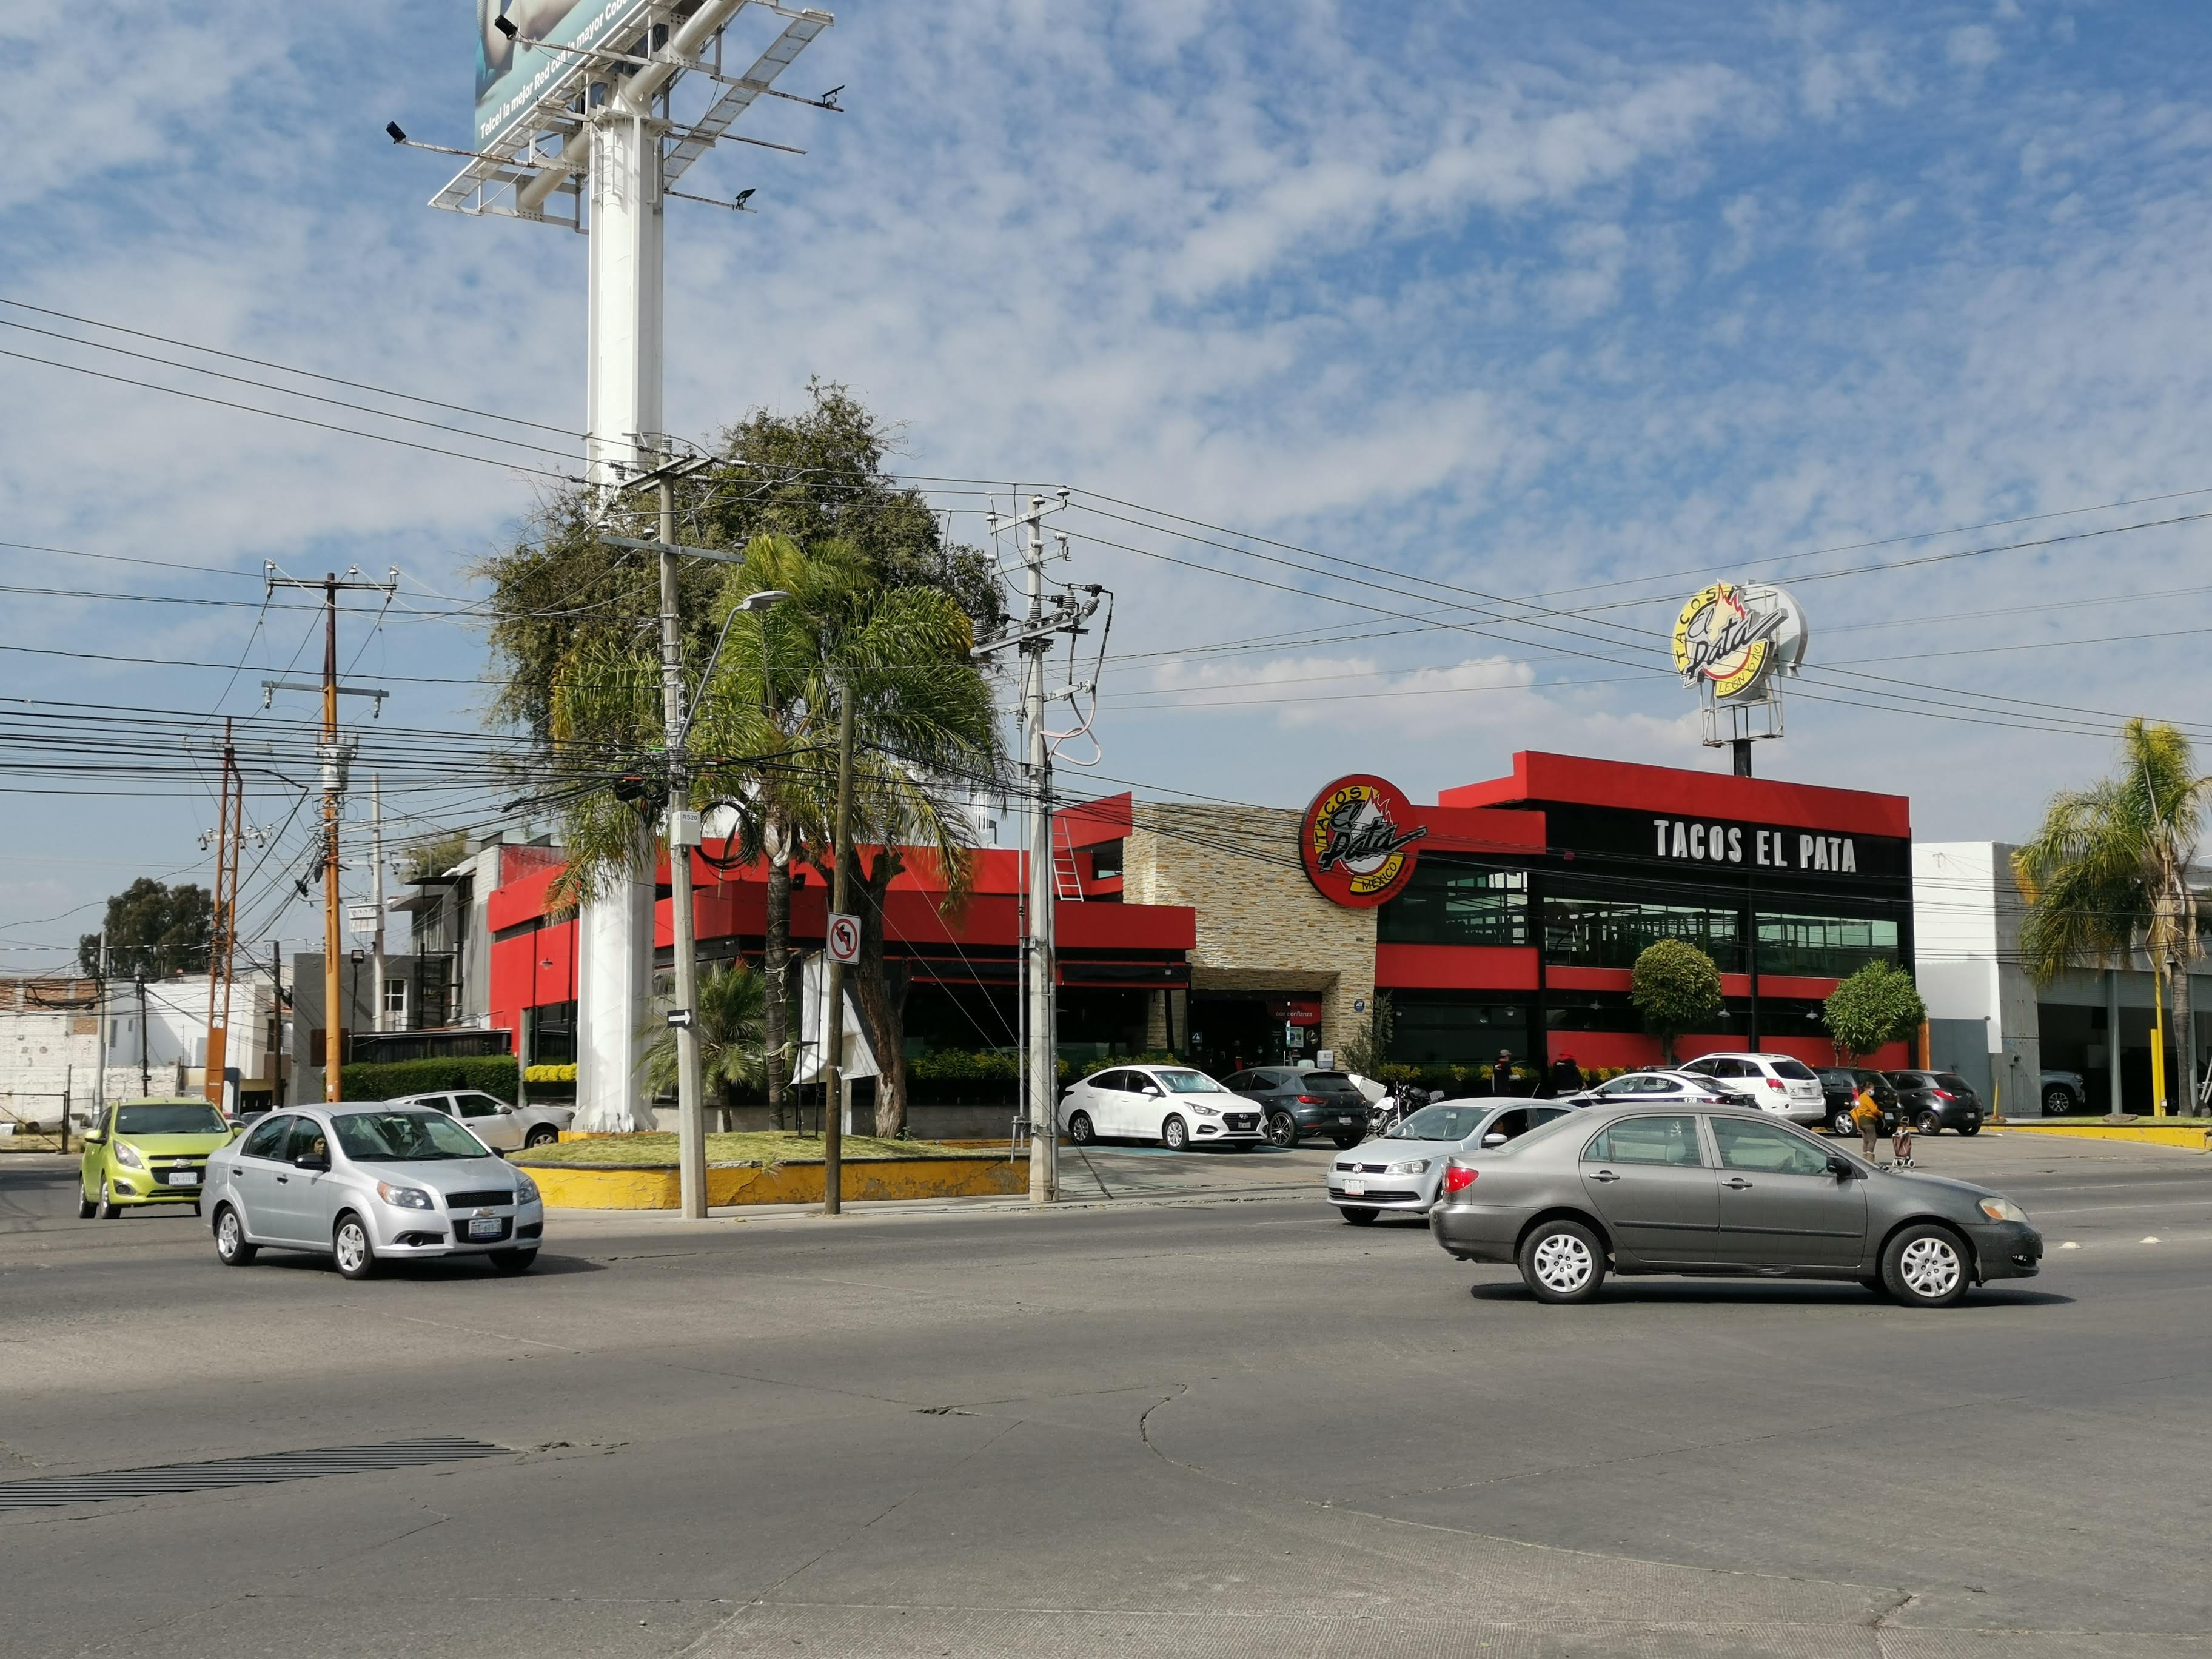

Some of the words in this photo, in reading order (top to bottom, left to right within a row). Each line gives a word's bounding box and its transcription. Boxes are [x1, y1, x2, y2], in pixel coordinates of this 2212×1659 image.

[480, 106, 502, 139] Telcel
[503, 102, 510, 119] la
[511, 81, 534, 112] mejor
[534, 61, 550, 90] Red
[551, 50, 566, 73] con
[577, 12, 604, 49] mayor
[1675, 588, 1717, 664] TACOS
[1686, 611, 1780, 680] Pata
[1687, 608, 1714, 638] El
[1314, 786, 1362, 845] TACOS
[1330, 800, 1364, 831] El
[1318, 817, 1427, 872] Pata
[1653, 819, 1743, 863] TACOS
[1756, 830, 1788, 867] EL
[1799, 834, 1857, 873] PATA
